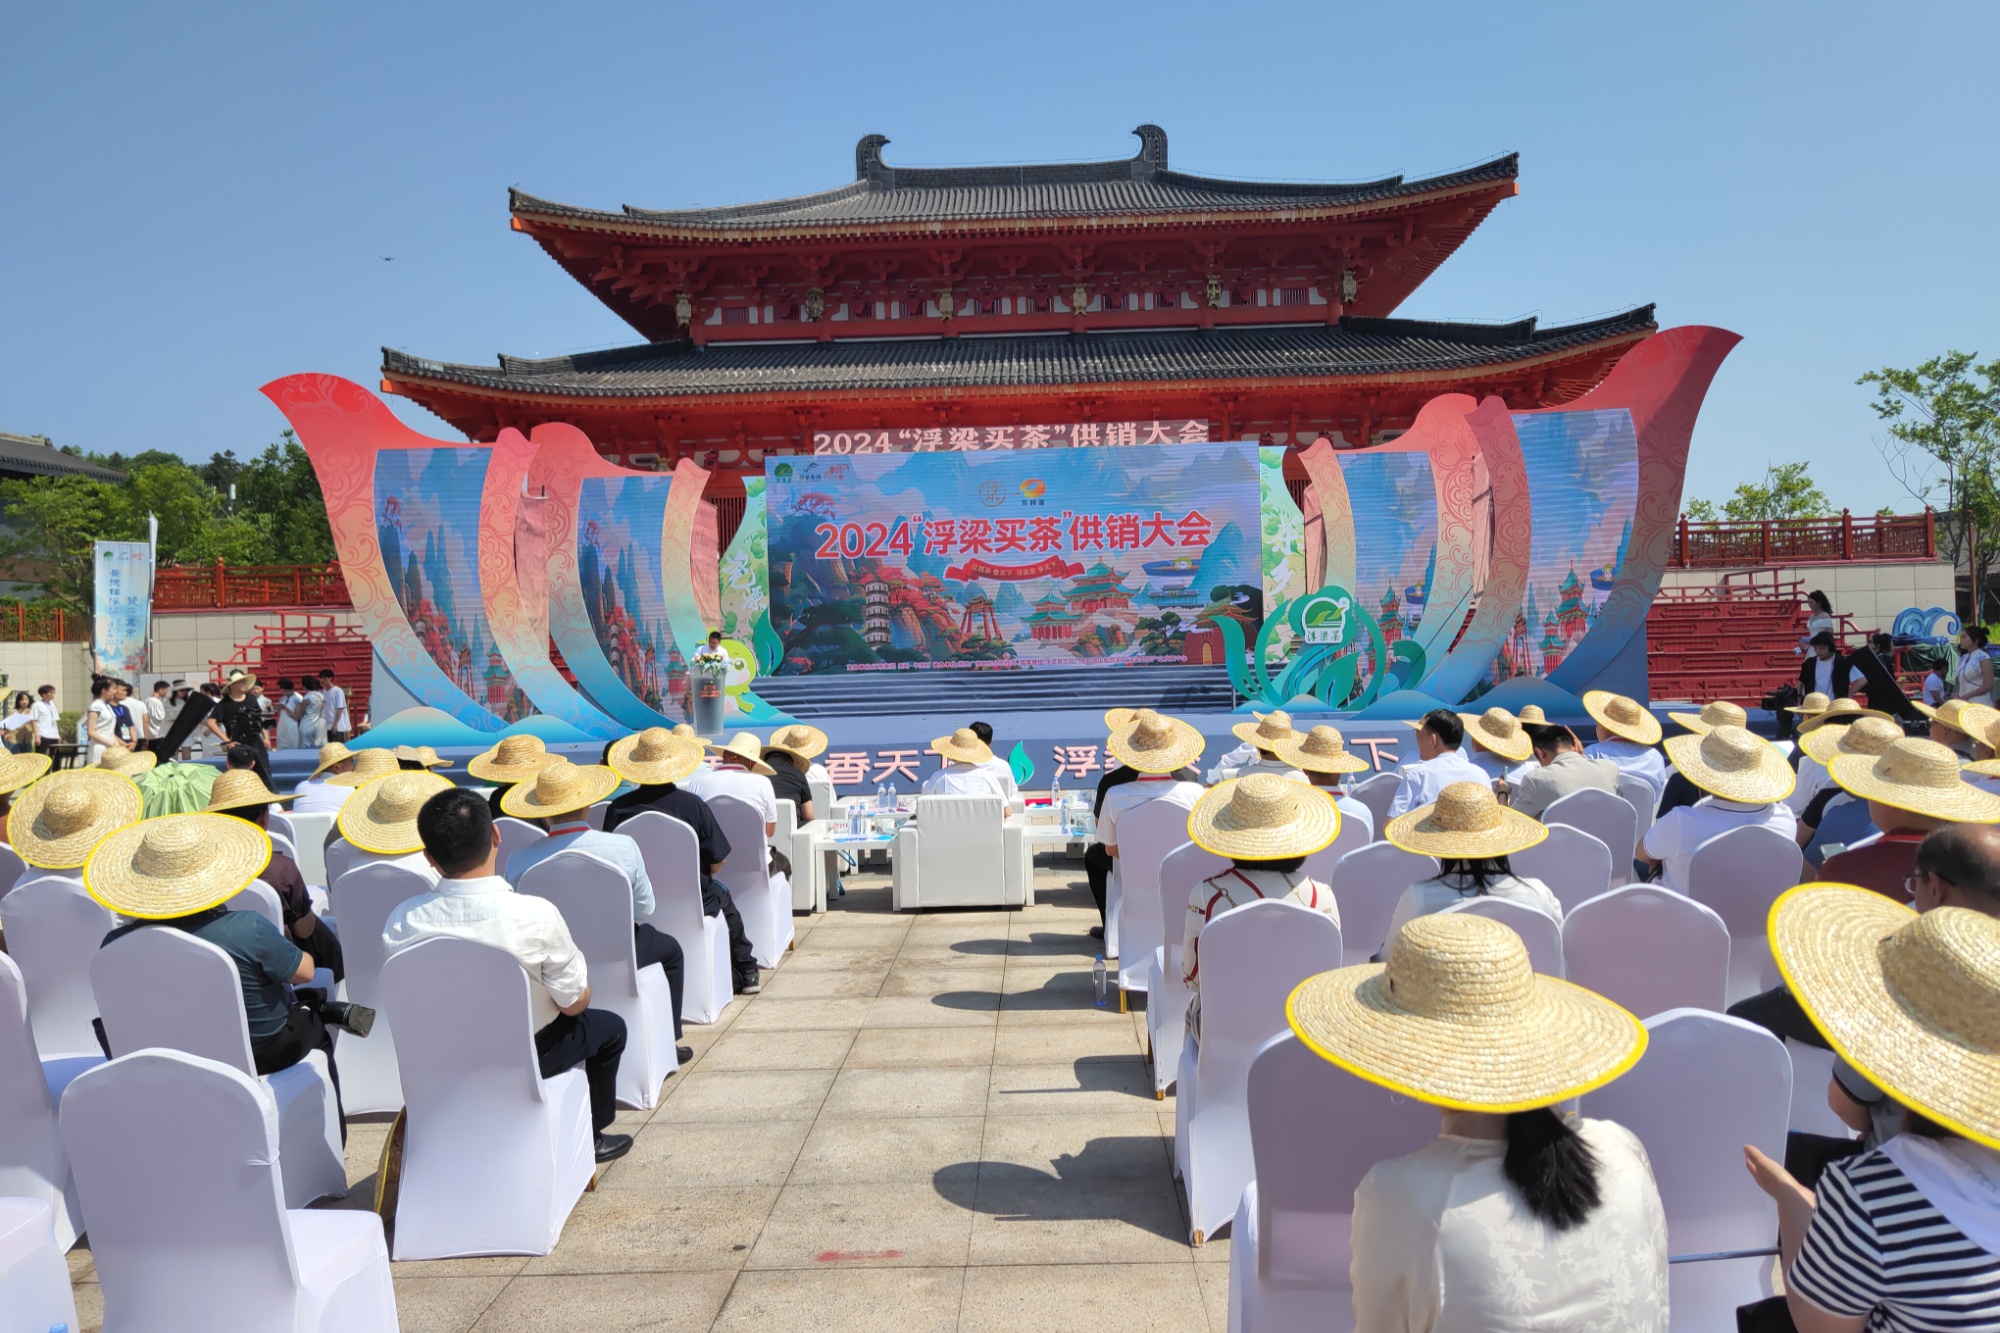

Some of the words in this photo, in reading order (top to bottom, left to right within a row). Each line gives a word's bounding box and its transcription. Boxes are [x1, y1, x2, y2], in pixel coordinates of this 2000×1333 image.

[813, 419, 1209, 455] 2024“浮梁买茶”供销大会
[814, 510, 1213, 560] 2024“浮梁买茶”供销大会
